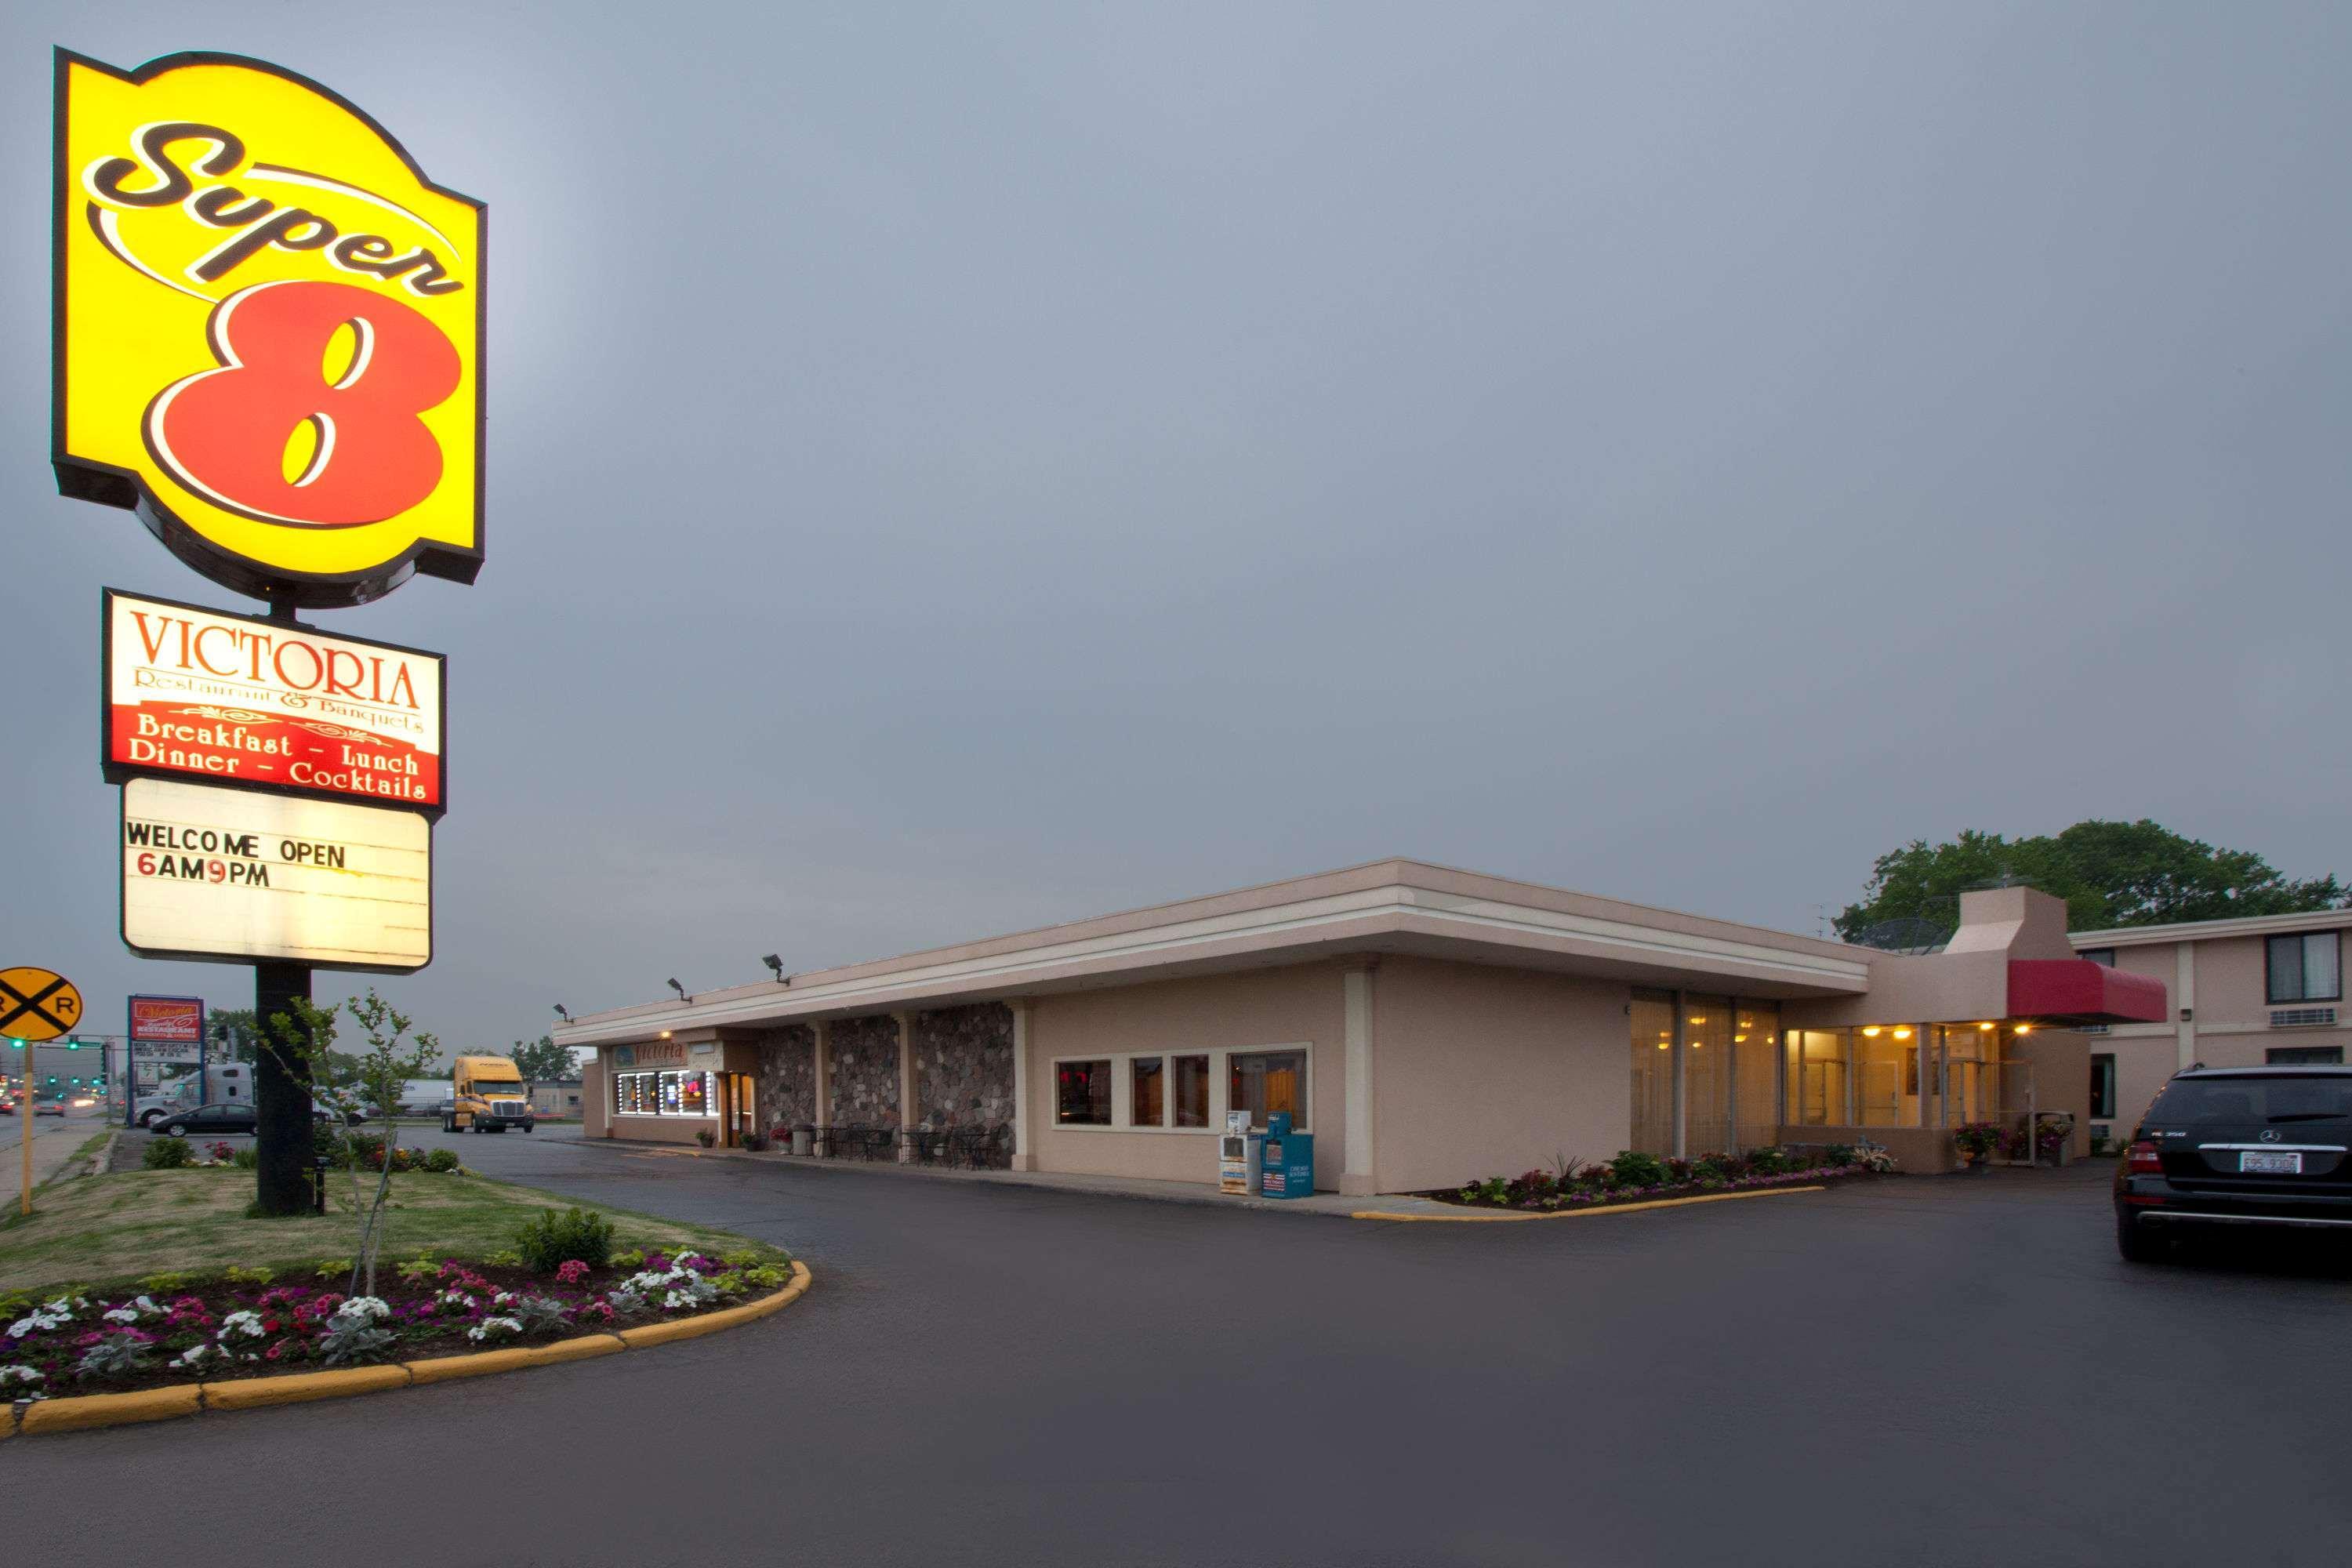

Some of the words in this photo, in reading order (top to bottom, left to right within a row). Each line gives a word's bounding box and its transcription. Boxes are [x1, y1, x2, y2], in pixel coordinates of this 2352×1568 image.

[82, 121, 464, 297] Super
[140, 280, 462, 530] 8
[129, 611, 420, 710] VICTORIA
[281, 691, 311, 709] &
[321, 701, 424, 734] Banquets
[129, 738, 240, 773] Dinner
[289, 761, 427, 800] Cocktails
[137, 713, 293, 757] Breakfast
[340, 745, 419, 776] Lunch
[126, 822, 260, 858] WELCOME
[280, 840, 345, 869] OPEN
[56, 996, 74, 1013] R
